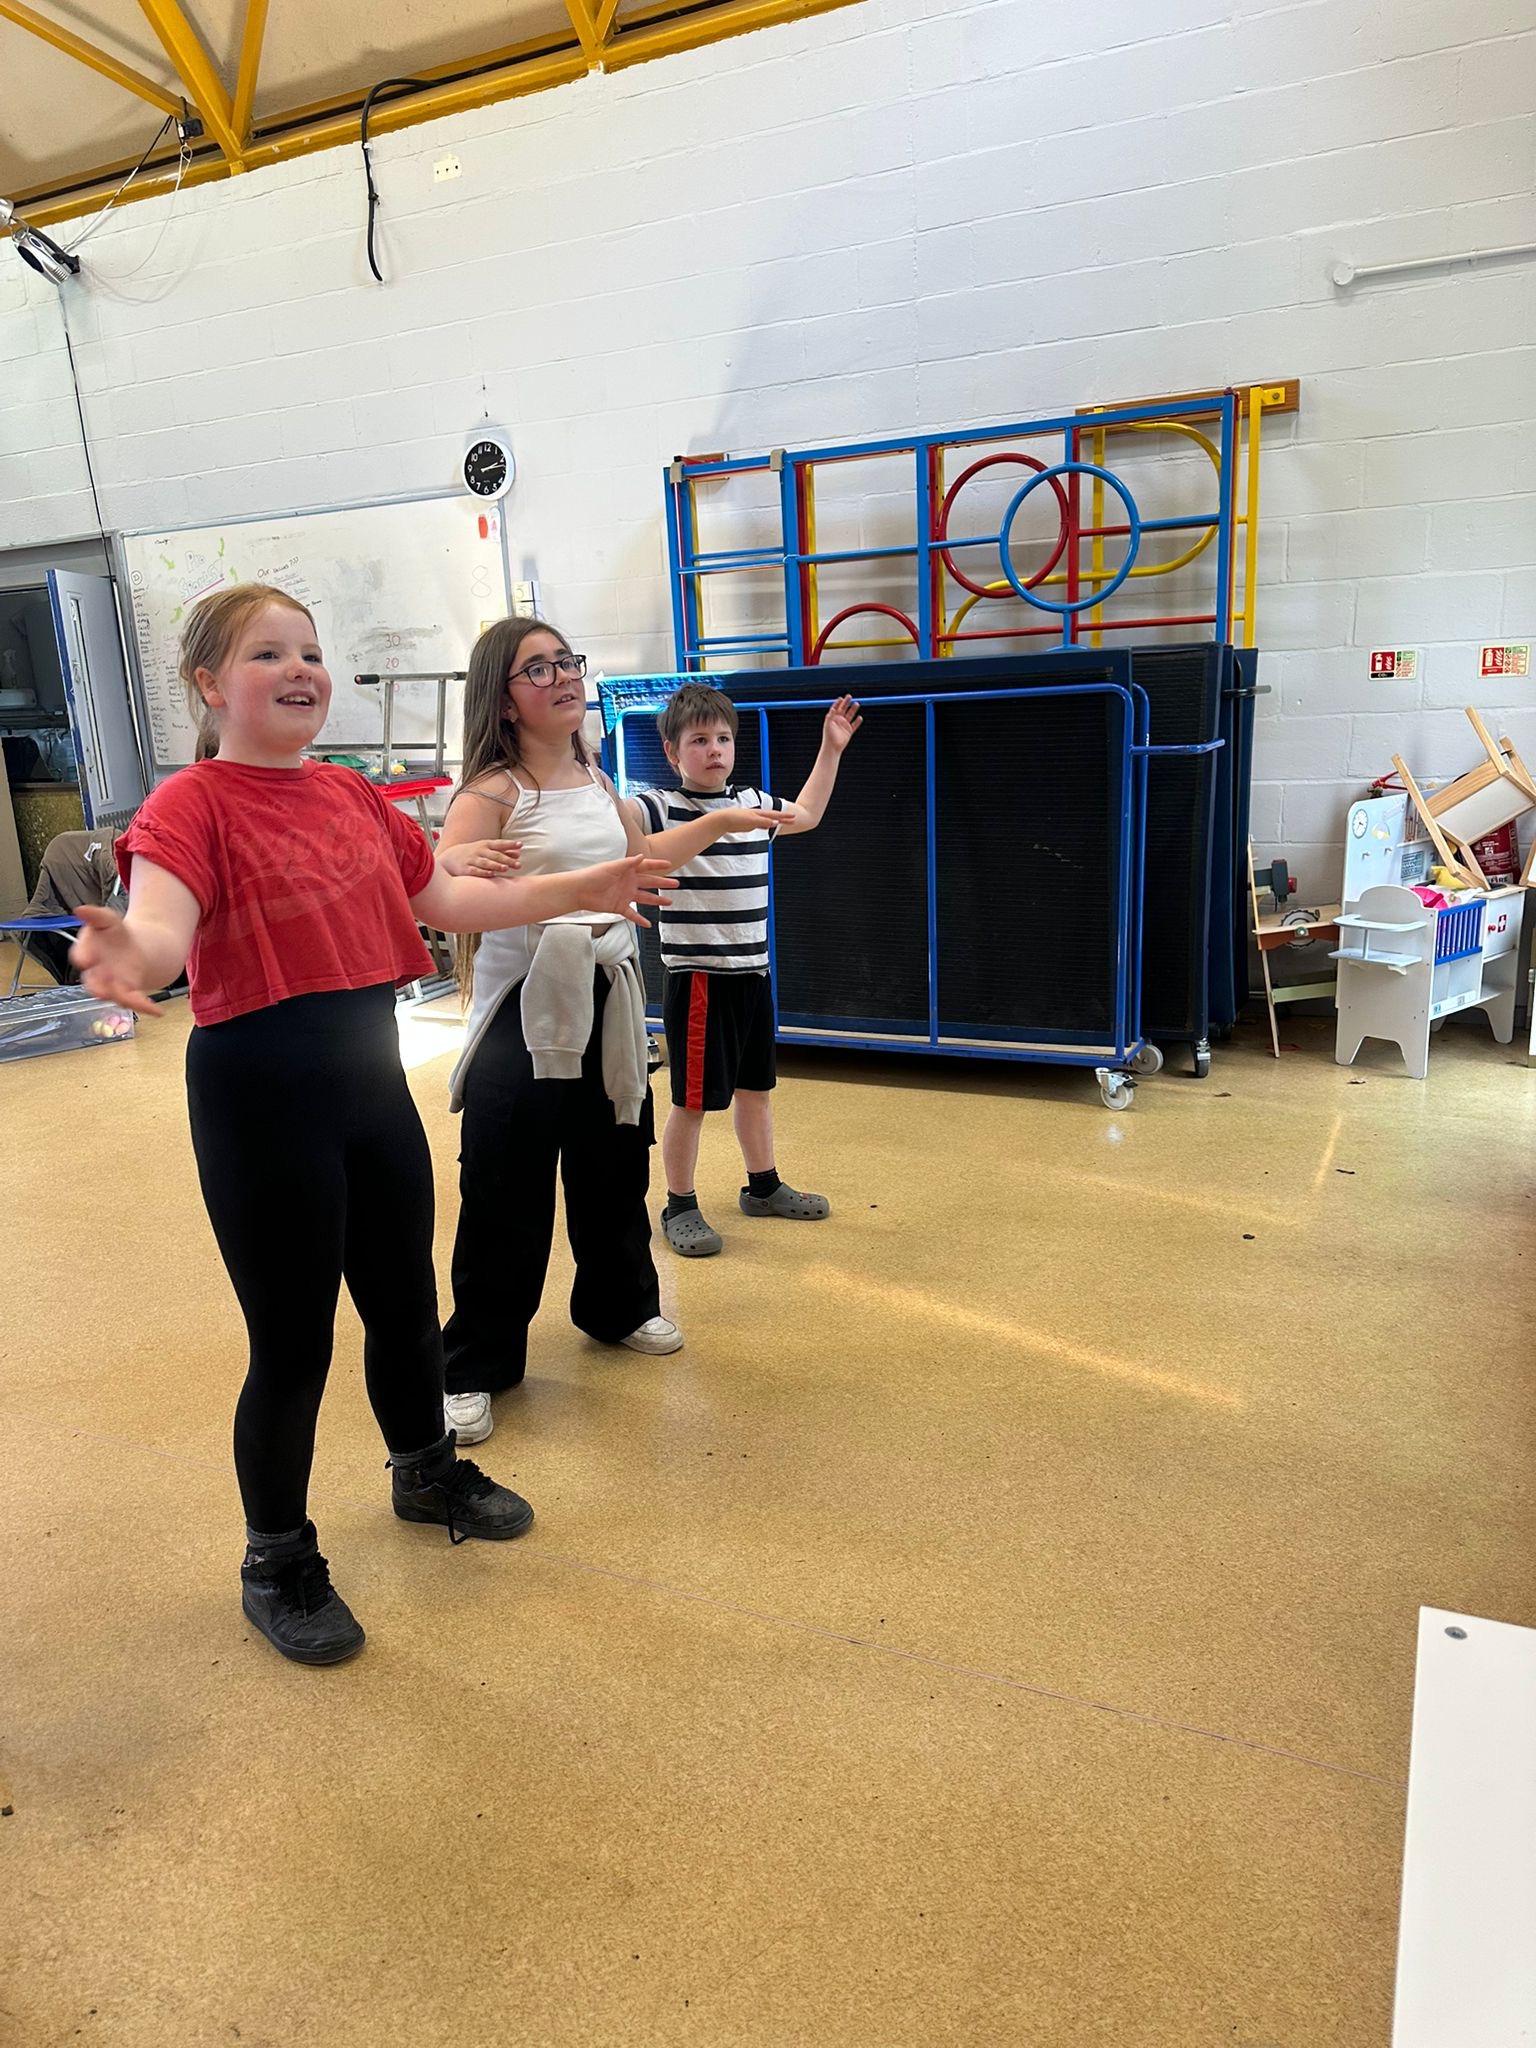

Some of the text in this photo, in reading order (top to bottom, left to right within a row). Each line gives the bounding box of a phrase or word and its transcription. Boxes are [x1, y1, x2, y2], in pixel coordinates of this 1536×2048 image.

[477, 445, 483, 454] 11
[484, 443, 492, 453] 12
[470, 453, 479, 462] 10
[499, 453, 505, 463] 2
[467, 464, 473, 473] 9
[469, 475, 476, 484] 8
[497, 476, 504, 484] 4
[475, 482, 481, 491] 7
[483, 485, 490, 494] 6
[492, 483, 498, 492] 5
[385, 633, 401, 649] 30
[385, 657, 400, 670] 20
